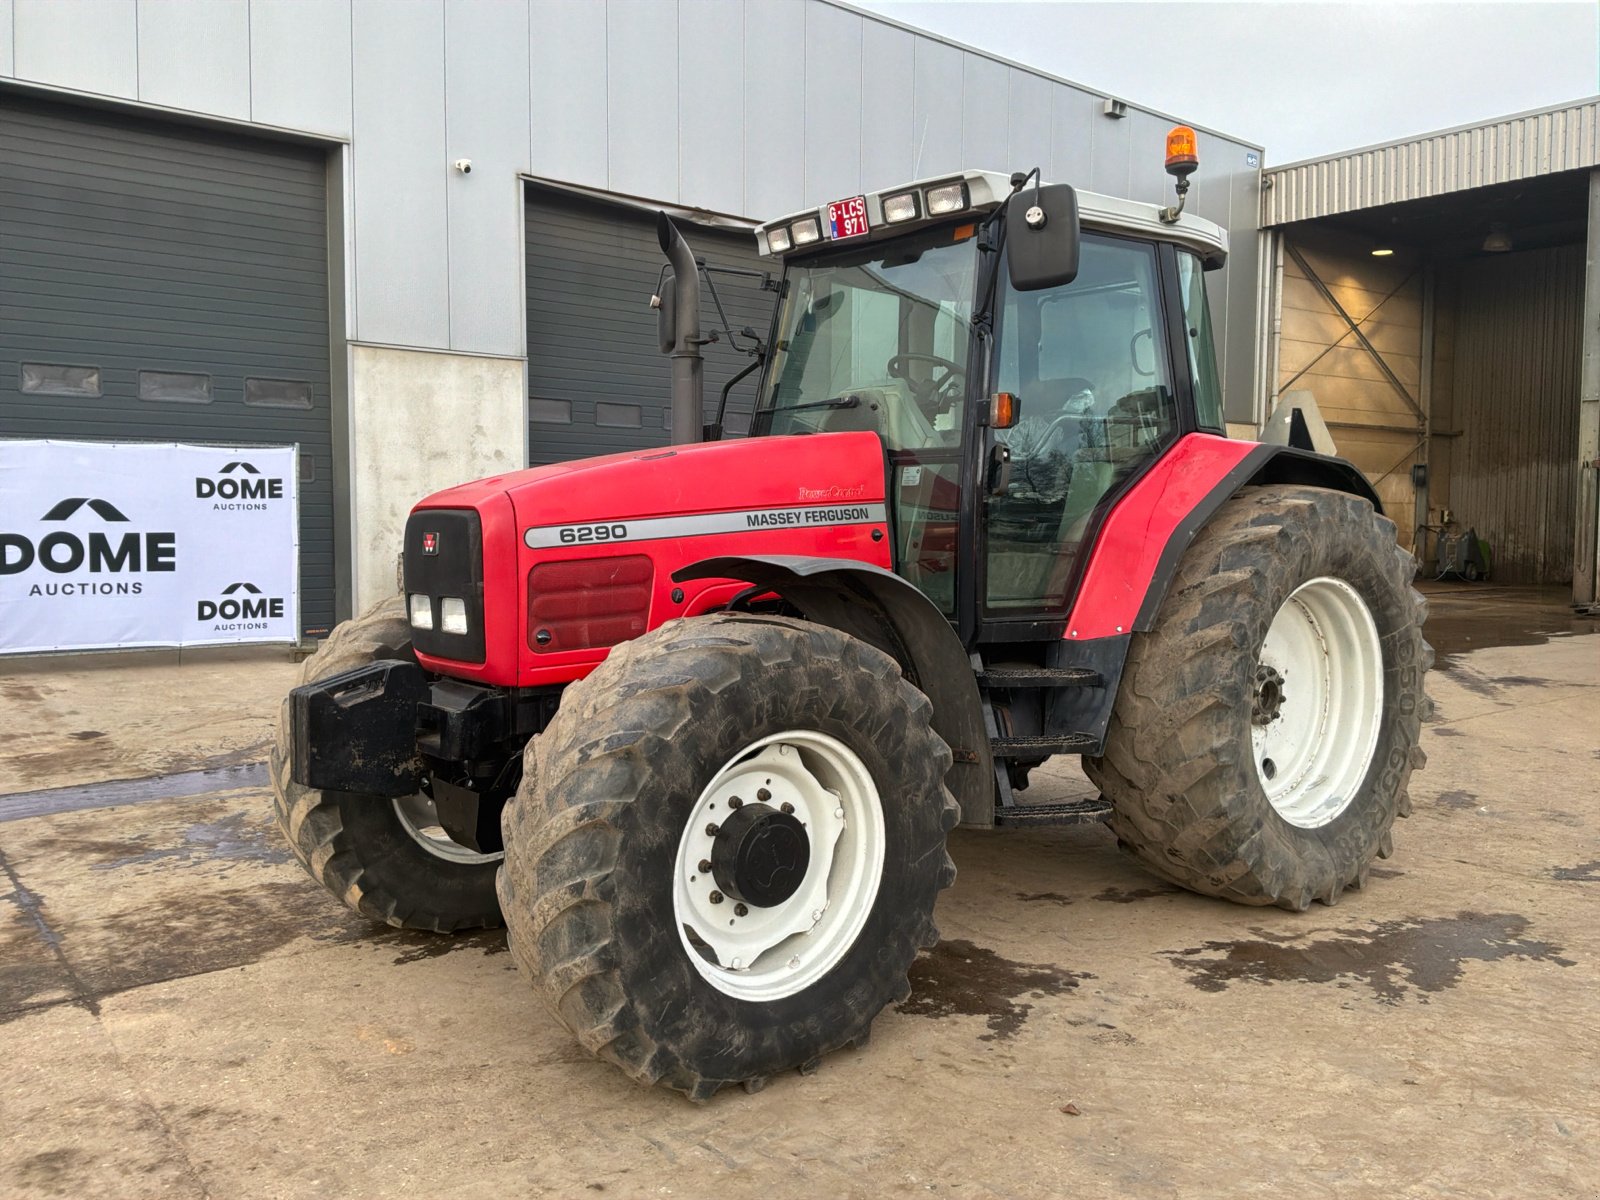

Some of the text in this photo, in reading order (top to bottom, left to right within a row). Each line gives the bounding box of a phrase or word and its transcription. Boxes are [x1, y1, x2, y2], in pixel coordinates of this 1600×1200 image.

[844, 216, 865, 235] 971
[195, 477, 283, 500] DOME
[213, 503, 267, 511] AUCTIONS
[746, 507, 869, 527] MASSEY FERGUSON
[559, 524, 628, 543] 6290
[0, 531, 176, 576] DOME
[29, 582, 143, 597] AUCTIONS
[197, 597, 284, 621] DOME
[214, 622, 268, 632] AUCTIONS
